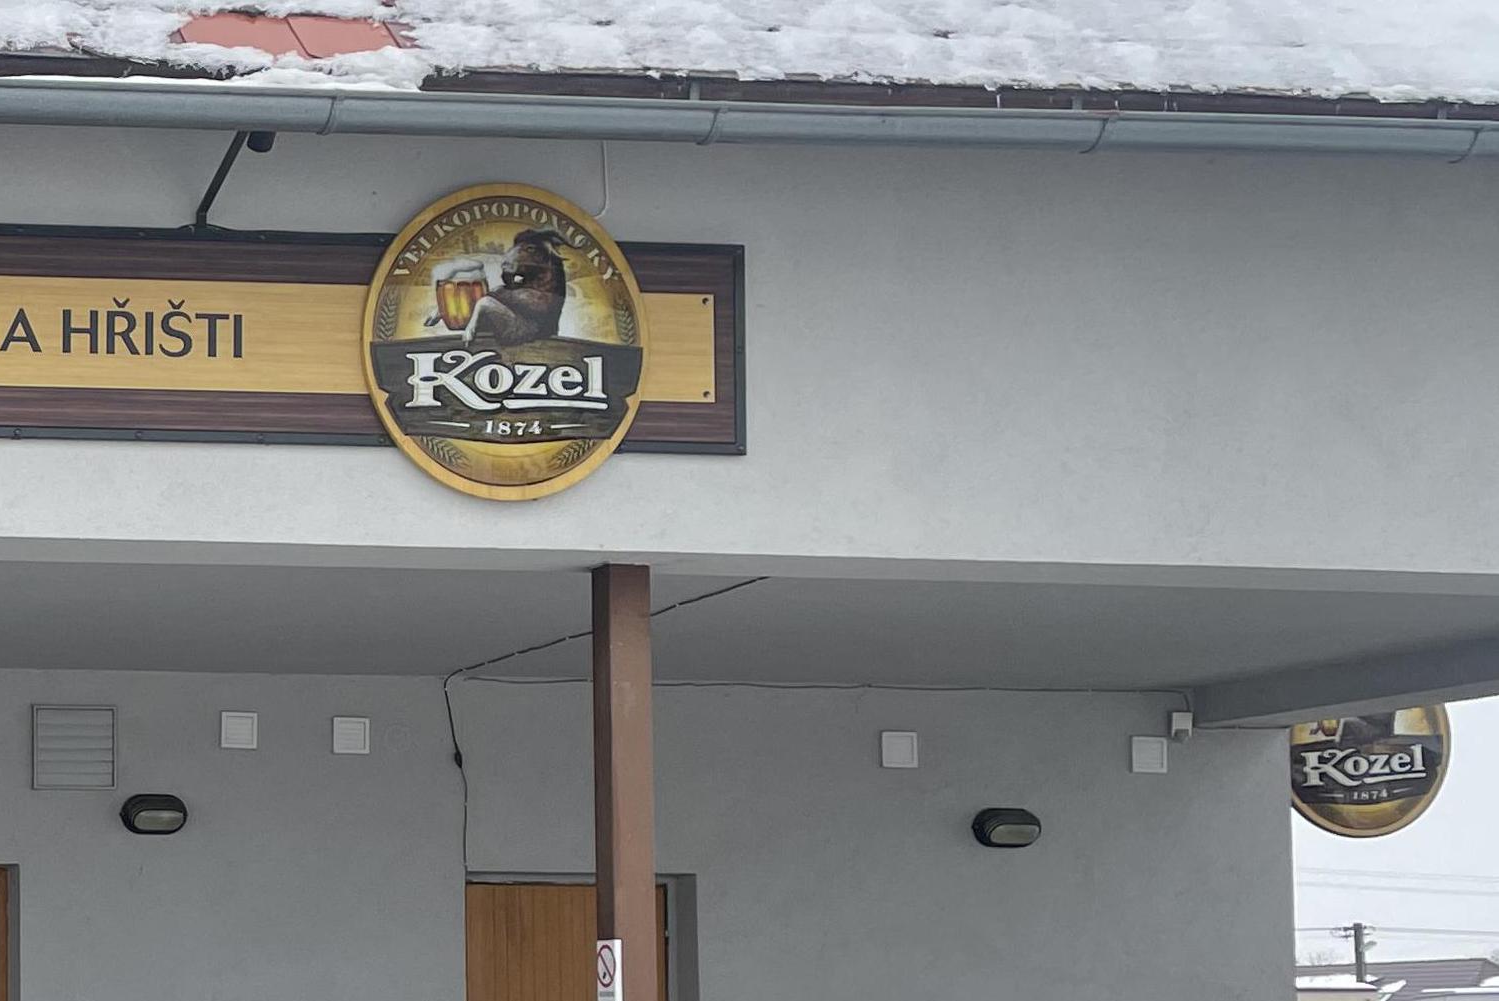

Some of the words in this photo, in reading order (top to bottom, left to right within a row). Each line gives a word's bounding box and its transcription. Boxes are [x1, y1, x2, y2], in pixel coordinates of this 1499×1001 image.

[62, 297, 244, 358] HŘIŠTI
[405, 350, 609, 411] Kozel
[486, 419, 543, 436] 1874
[1300, 743, 1427, 787] Kozel
[1353, 788, 1389, 800] 1874
